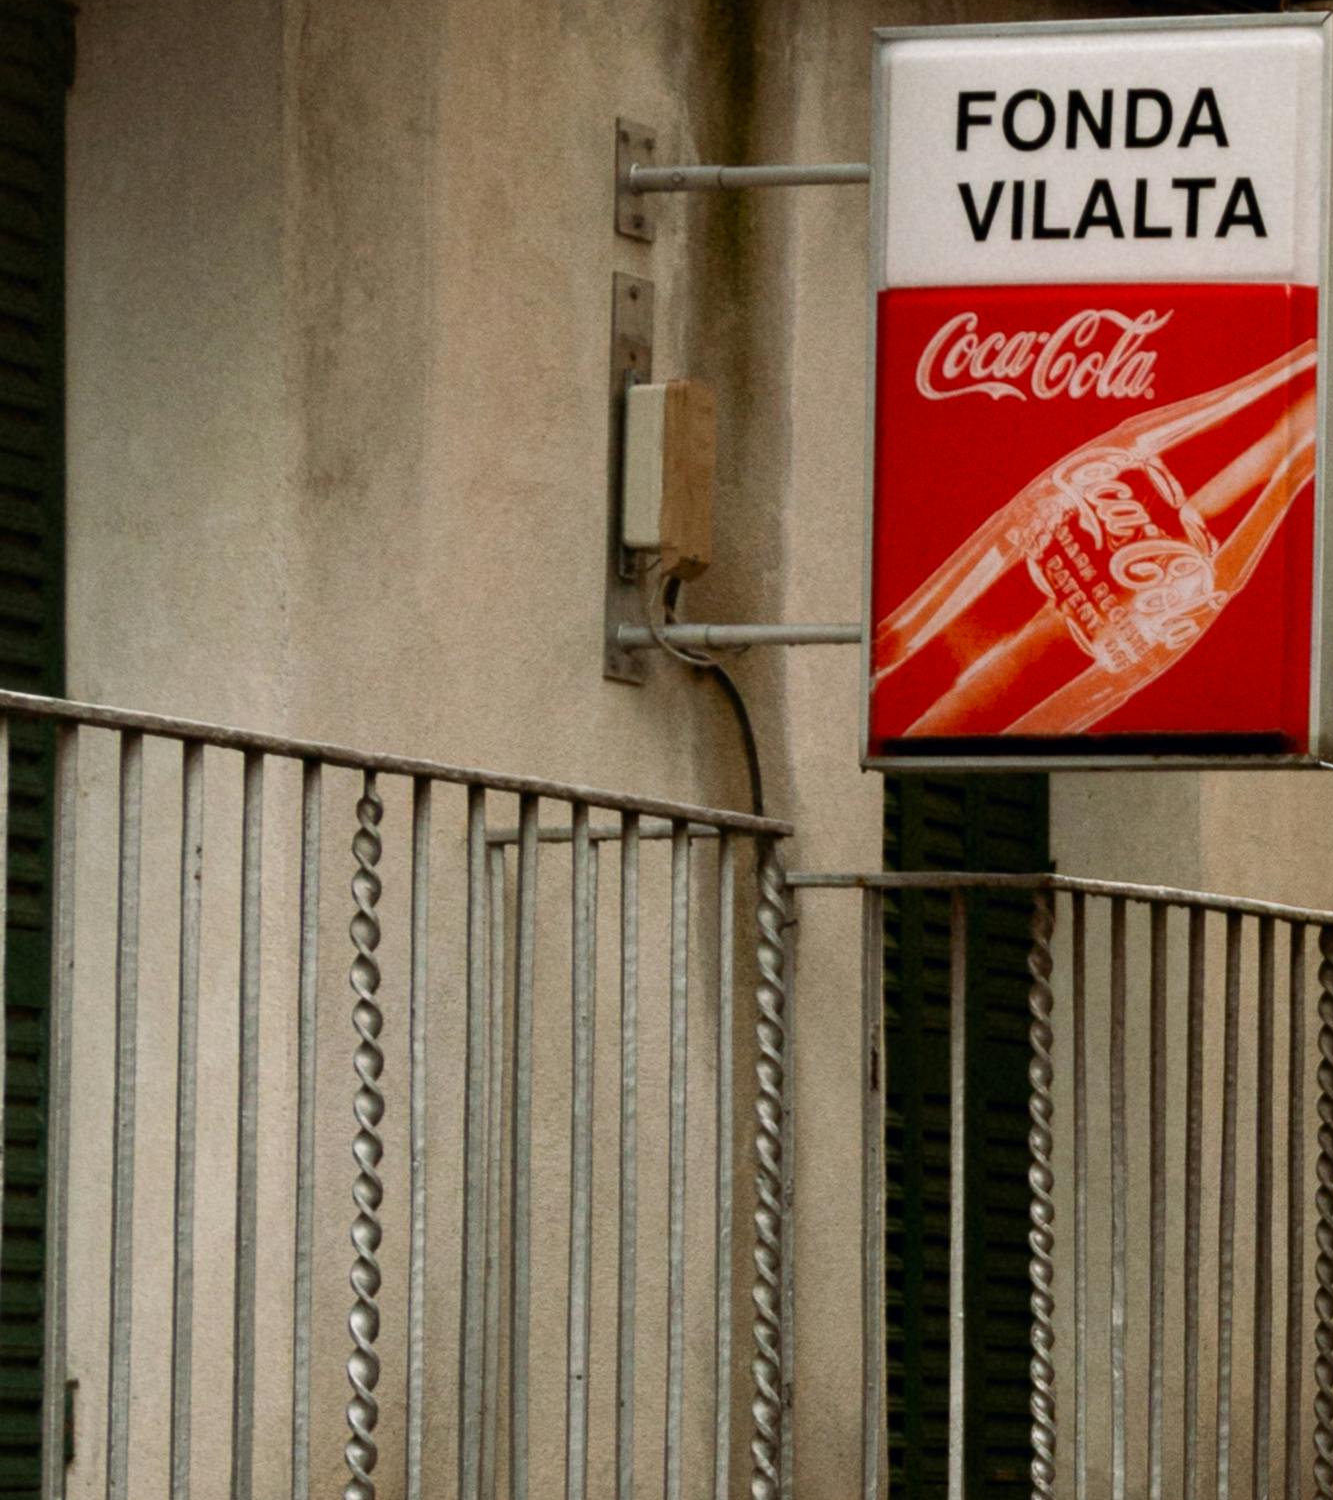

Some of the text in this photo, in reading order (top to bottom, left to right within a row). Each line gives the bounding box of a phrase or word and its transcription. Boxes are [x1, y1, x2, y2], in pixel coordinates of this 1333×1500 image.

[956, 87, 1229, 151] FONDA
[957, 177, 1268, 242] VILALTA
[915, 308, 1174, 401] Coca-Cola
